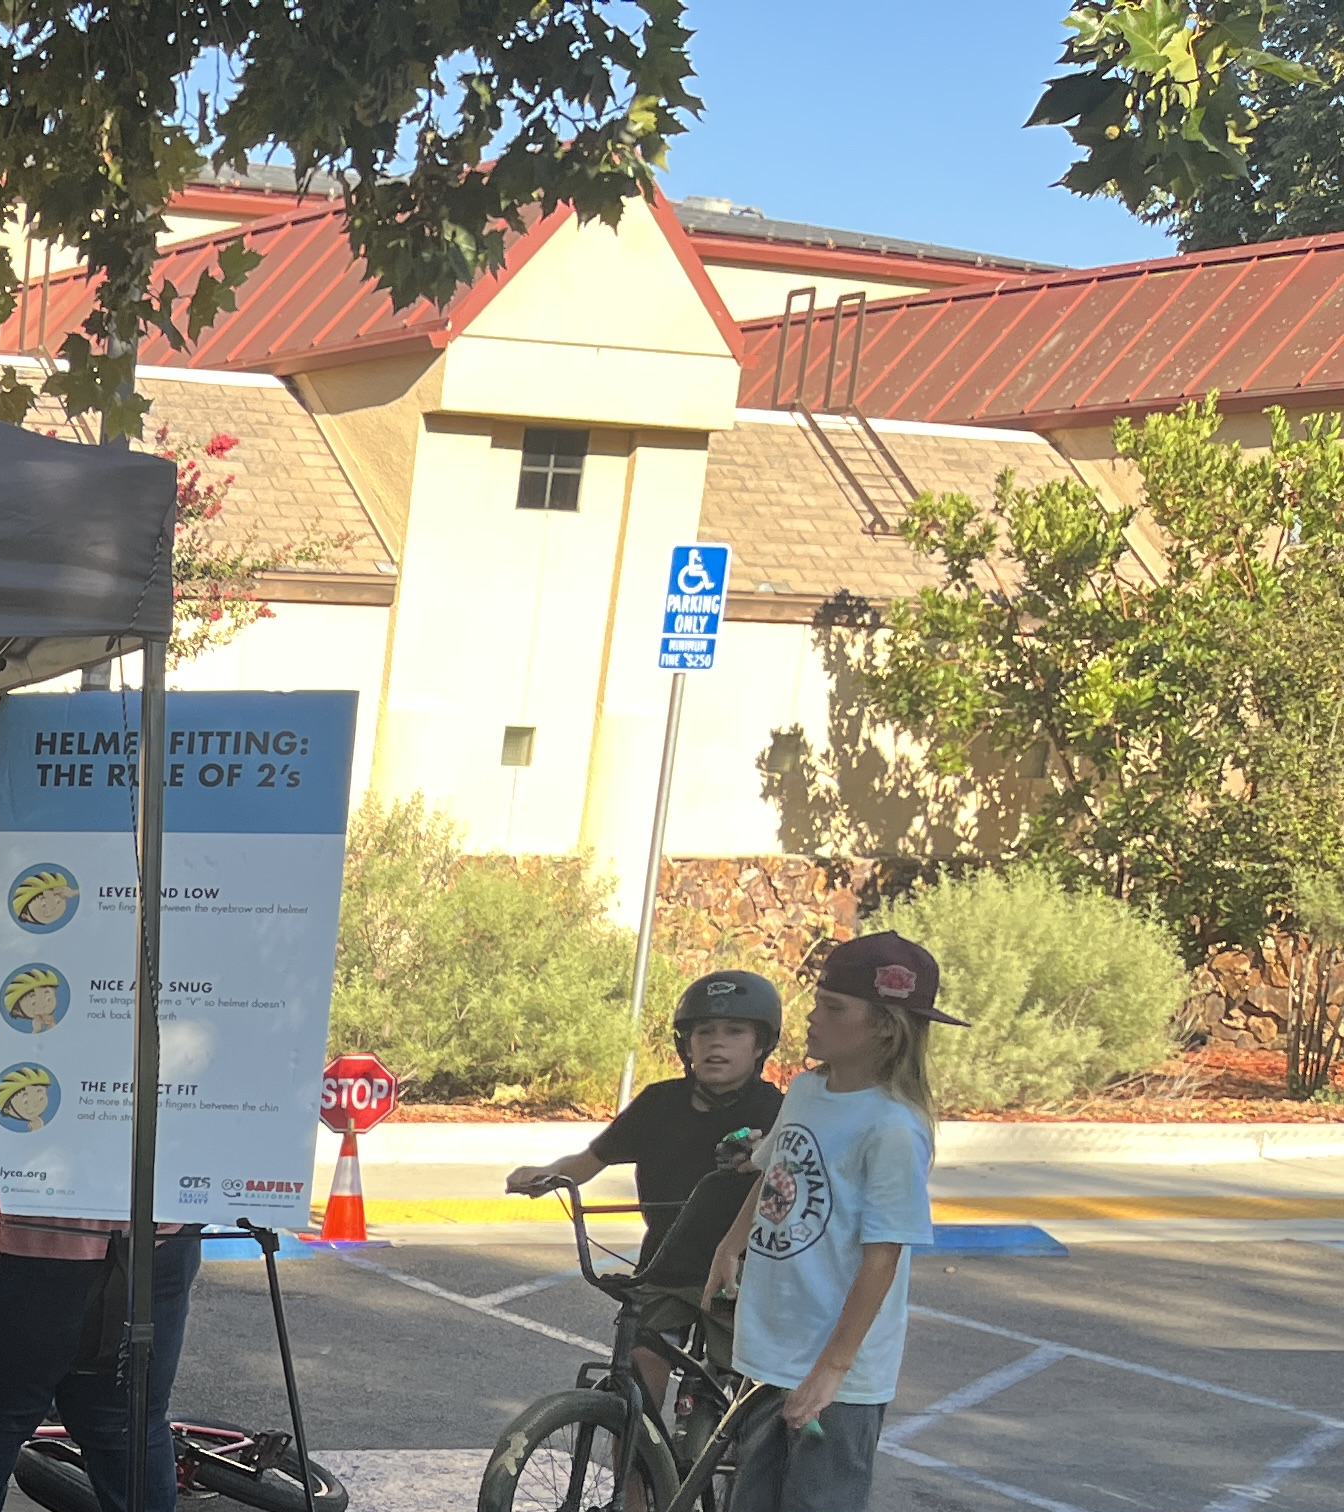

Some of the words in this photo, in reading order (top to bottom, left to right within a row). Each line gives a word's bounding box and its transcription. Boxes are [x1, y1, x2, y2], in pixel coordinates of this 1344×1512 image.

[667, 594, 720, 614] PARKING
[674, 614, 709, 634] ONLY
[34, 731, 139, 756] HELME
[169, 730, 310, 756] FITTING:
[37, 763, 94, 787] THE
[198, 763, 243, 787] OF
[257, 763, 301, 788] 2's
[184, 888, 220, 899] LOW
[98, 902, 115, 911] Two
[194, 904, 209, 913] the
[211, 904, 253, 915] eyebrow
[255, 905, 274, 915] and
[276, 904, 309, 915] helmet
[90, 979, 124, 991] NICE
[169, 981, 213, 994] SNUG
[89, 995, 107, 1004] Two
[204, 999, 214, 1008] so
[217, 997, 249, 1008] helmet
[87, 1010, 106, 1019] rock
[110, 1011, 132, 1020] back
[81, 1081, 107, 1092] THE
[177, 1085, 198, 1096] FIT
[321, 1077, 389, 1111] STOP
[79, 1096, 94, 1105] No
[165, 1099, 197, 1111] fingers
[200, 1100, 239, 1111] between
[242, 1101, 257, 1111] the
[259, 1103, 279, 1113] chin
[77, 1112, 95, 1121] and
[98, 1112, 117, 1121] chin
[245, 1180, 304, 1193] SAFELY
[799, 1149, 825, 1220] WALL
